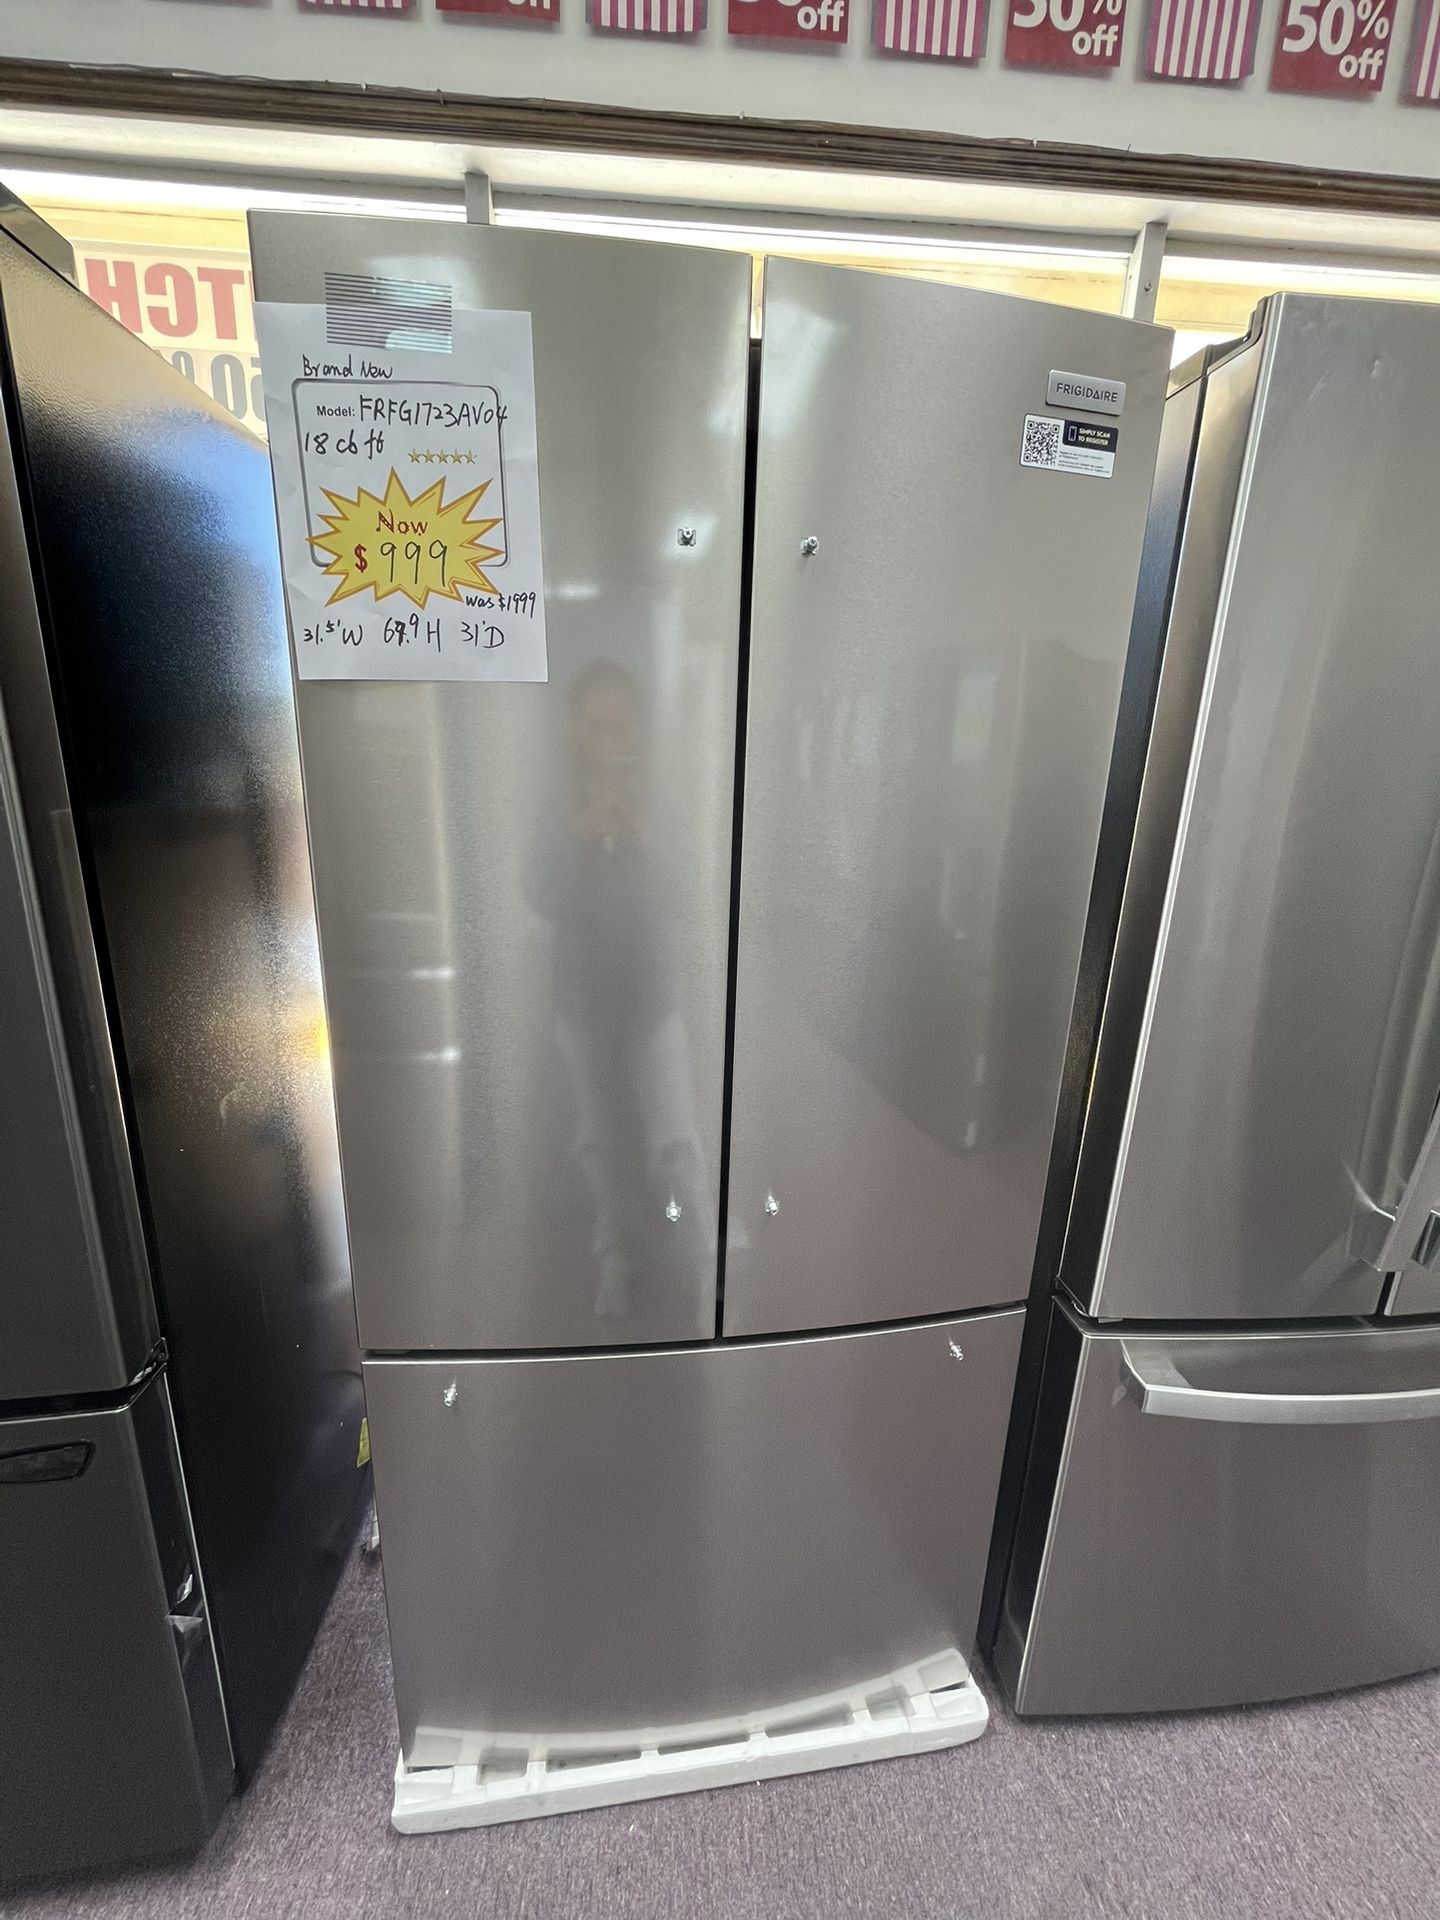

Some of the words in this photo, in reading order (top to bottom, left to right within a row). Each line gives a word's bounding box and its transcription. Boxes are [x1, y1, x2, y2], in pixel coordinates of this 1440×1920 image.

[797, 0, 844, 32] off
[1282, 0, 1389, 56] 50%
[1072, 23, 1119, 57] off
[1338, 47, 1384, 81] off
[302, 353, 353, 378] Brand
[360, 360, 393, 379] New
[1056, 382, 1118, 403] FRIGIDAIRE
[316, 405, 356, 417] Model:
[304, 431, 329, 455] 18
[376, 508, 428, 536] Now
[498, 591, 536, 619] $1999
